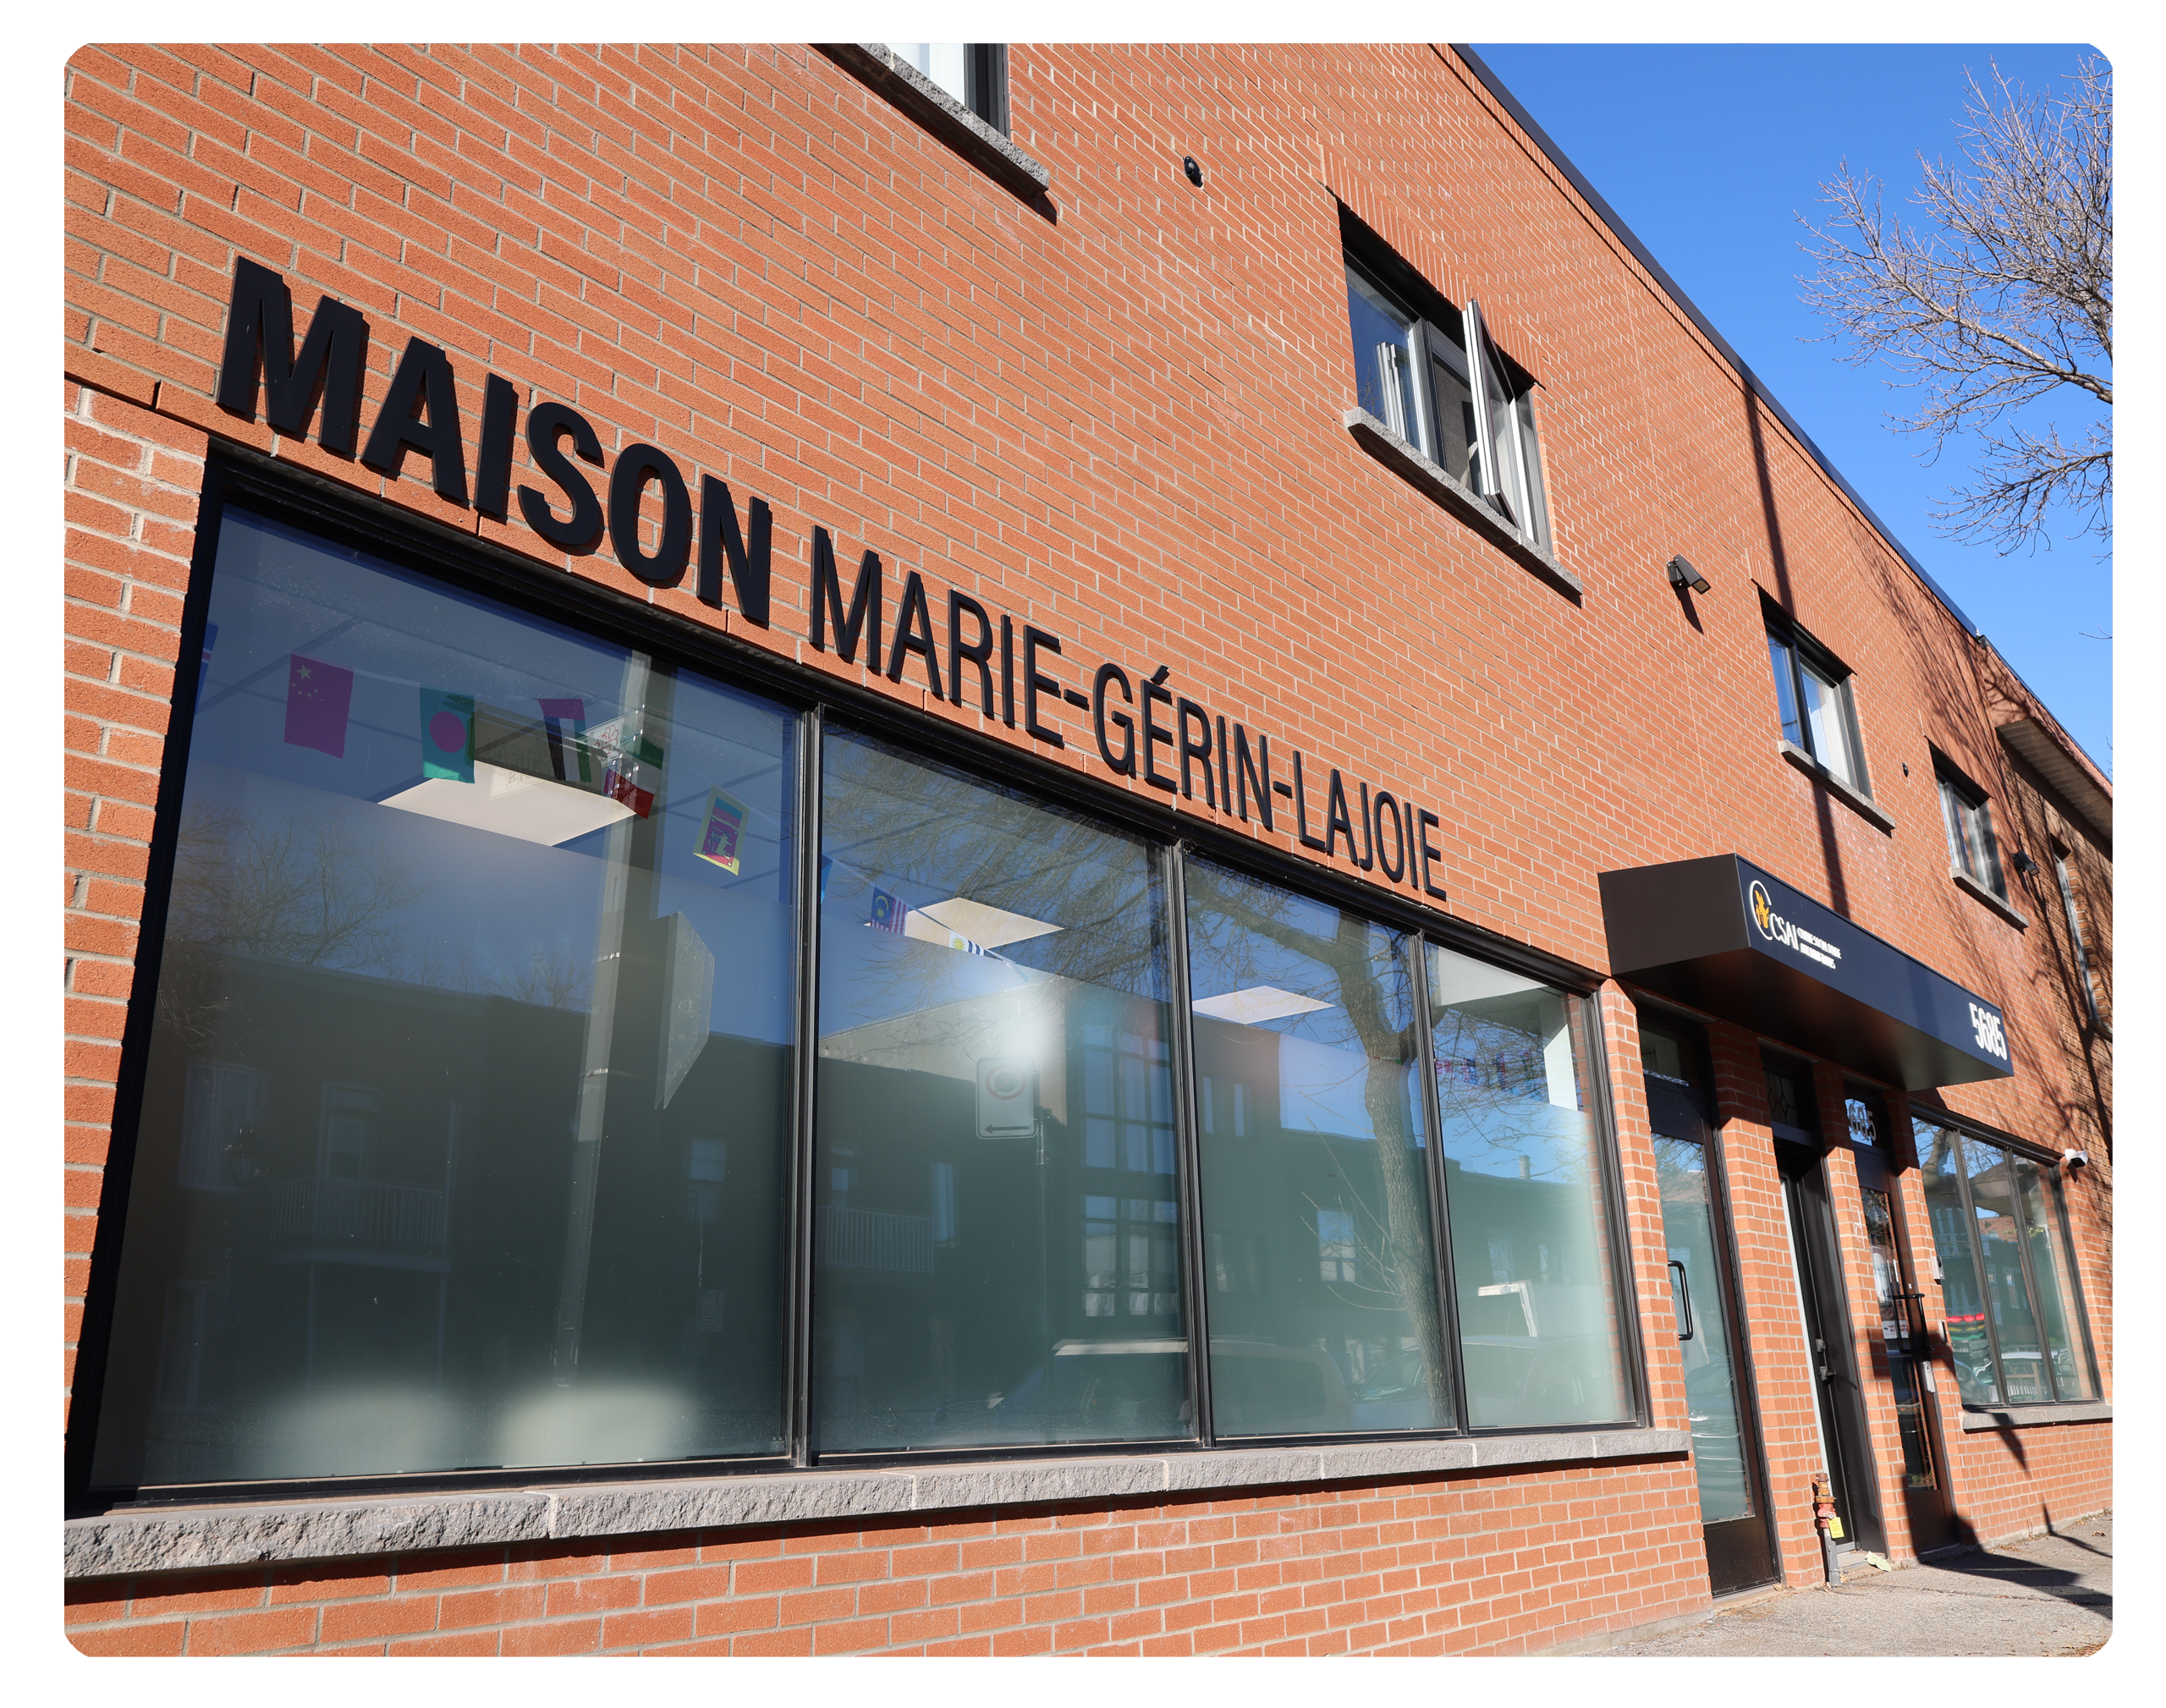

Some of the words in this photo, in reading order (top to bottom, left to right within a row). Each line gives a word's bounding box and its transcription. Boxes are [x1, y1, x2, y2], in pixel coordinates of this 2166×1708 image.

[216, 255, 770, 628] MAISON
[809, 524, 1448, 901] MARIE-GÉRIN-LAJOIE
[1769, 913, 1800, 951] CSAI
[1968, 1002, 2009, 1061] 5685
